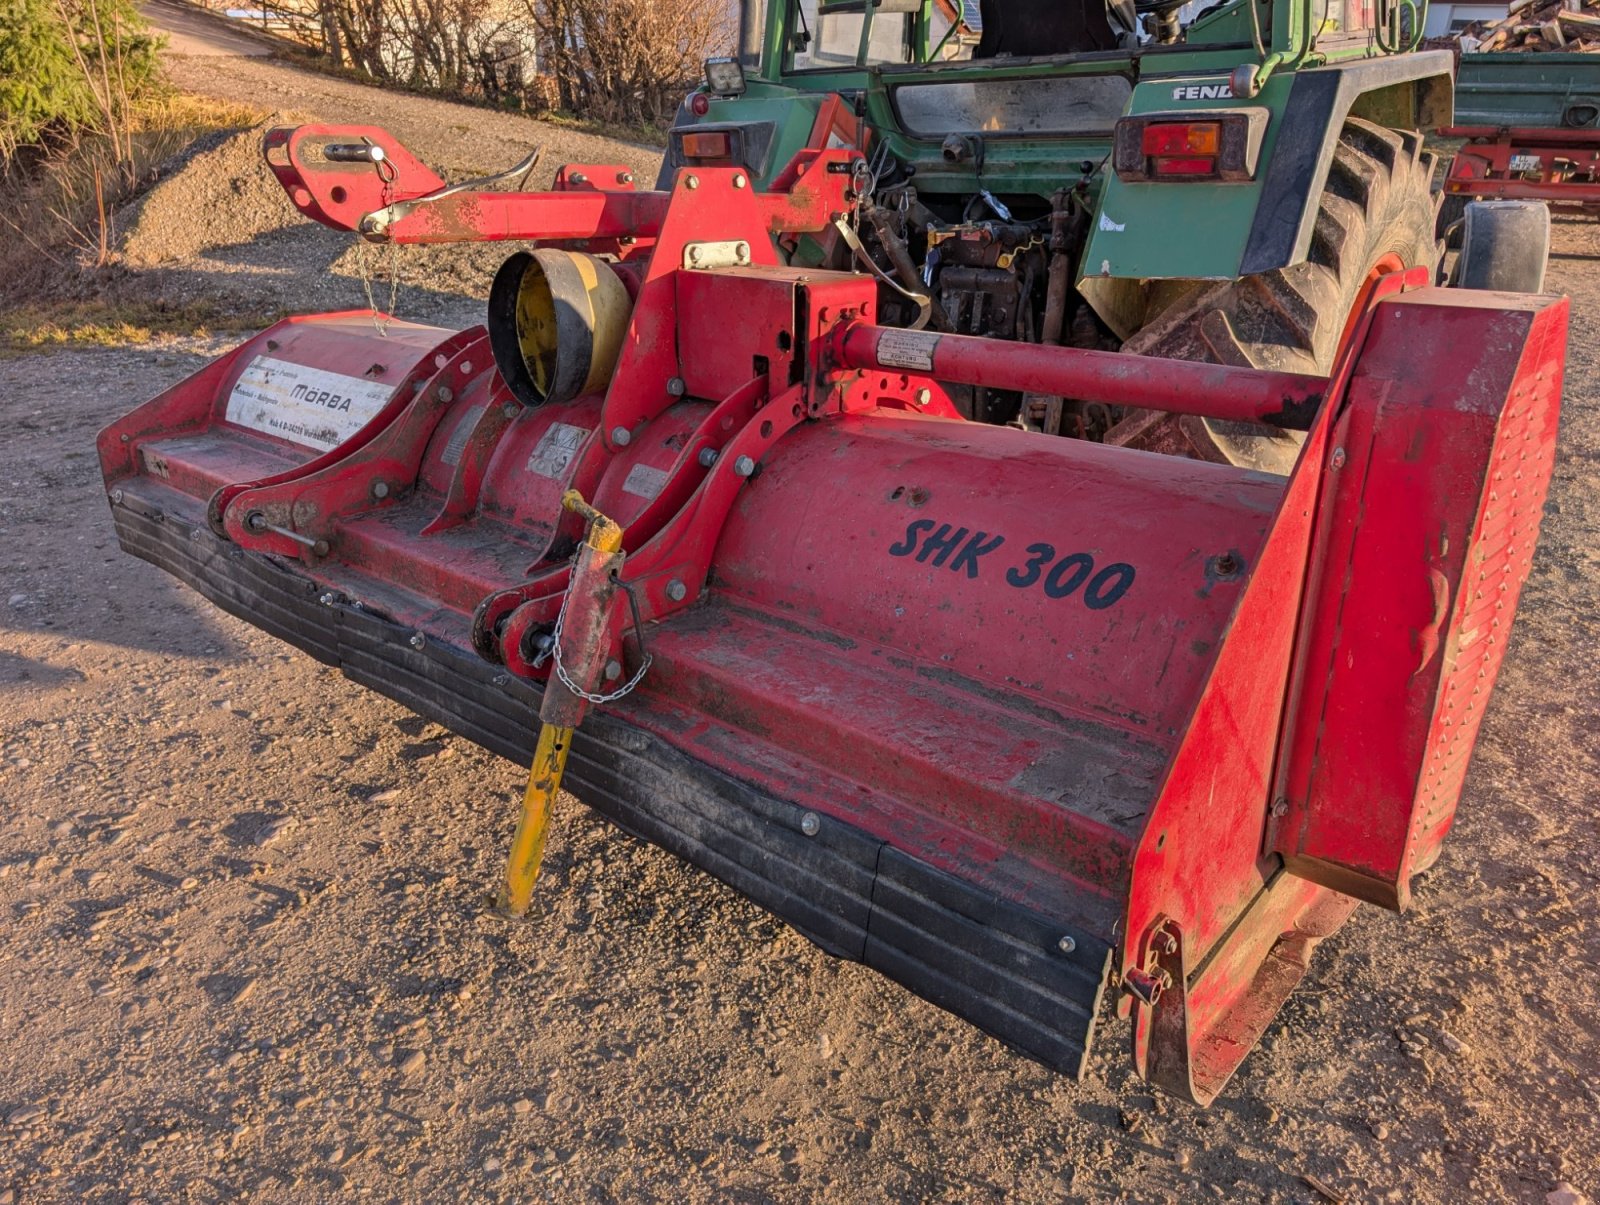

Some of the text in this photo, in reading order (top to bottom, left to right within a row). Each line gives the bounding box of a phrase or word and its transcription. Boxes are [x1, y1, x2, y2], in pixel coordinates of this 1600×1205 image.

[1172, 85, 1233, 100] FEND
[290, 383, 352, 413] MÖRBA
[888, 519, 1137, 611] SHK 300
